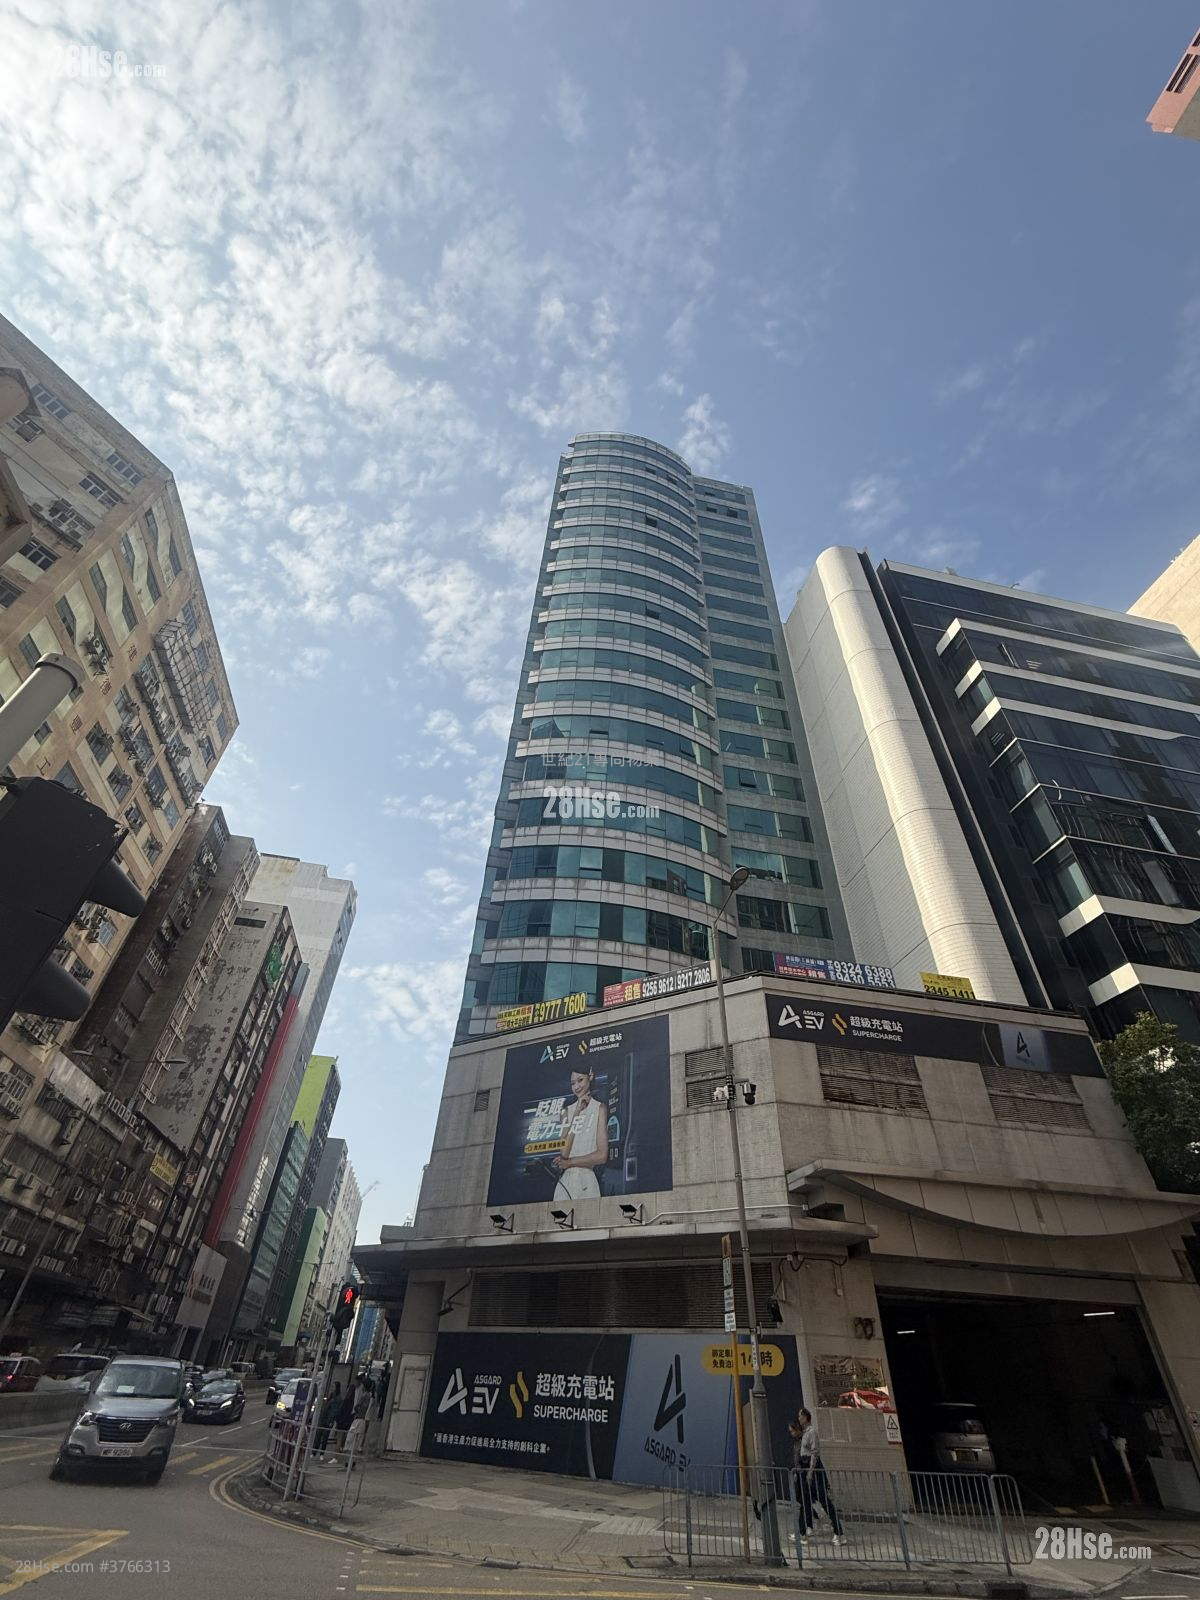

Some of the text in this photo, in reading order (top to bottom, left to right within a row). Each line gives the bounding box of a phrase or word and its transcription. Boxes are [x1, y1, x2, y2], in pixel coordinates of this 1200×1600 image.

[834, 960, 862, 975] 9324
[865, 965, 893, 979] 6388
[642, 980, 658, 998] 9256
[658, 976, 674, 994] 9612
[677, 972, 692, 989] 9217
[694, 967, 710, 985] 2806
[624, 983, 641, 1001] 租售
[924, 985, 976, 1000] 2345 1411
[540, 999, 562, 1022] 9777
[563, 993, 586, 1016] 7600
[850, 1015, 904, 1033] 超級充電站
[589, 1032, 622, 1046] 超級充電站
[852, 1029, 903, 1042] SUPERCHARGE
[711, 1348, 733, 1358] 綁定車
[712, 1359, 734, 1369] 免費泊
[474, 1374, 502, 1385] ASGARD
[535, 1372, 615, 1401] 超級充電站
[471, 1386, 500, 1415] EV
[533, 1404, 608, 1423] SUPERCHARGE
[644, 1436, 676, 1465] ASGARD
